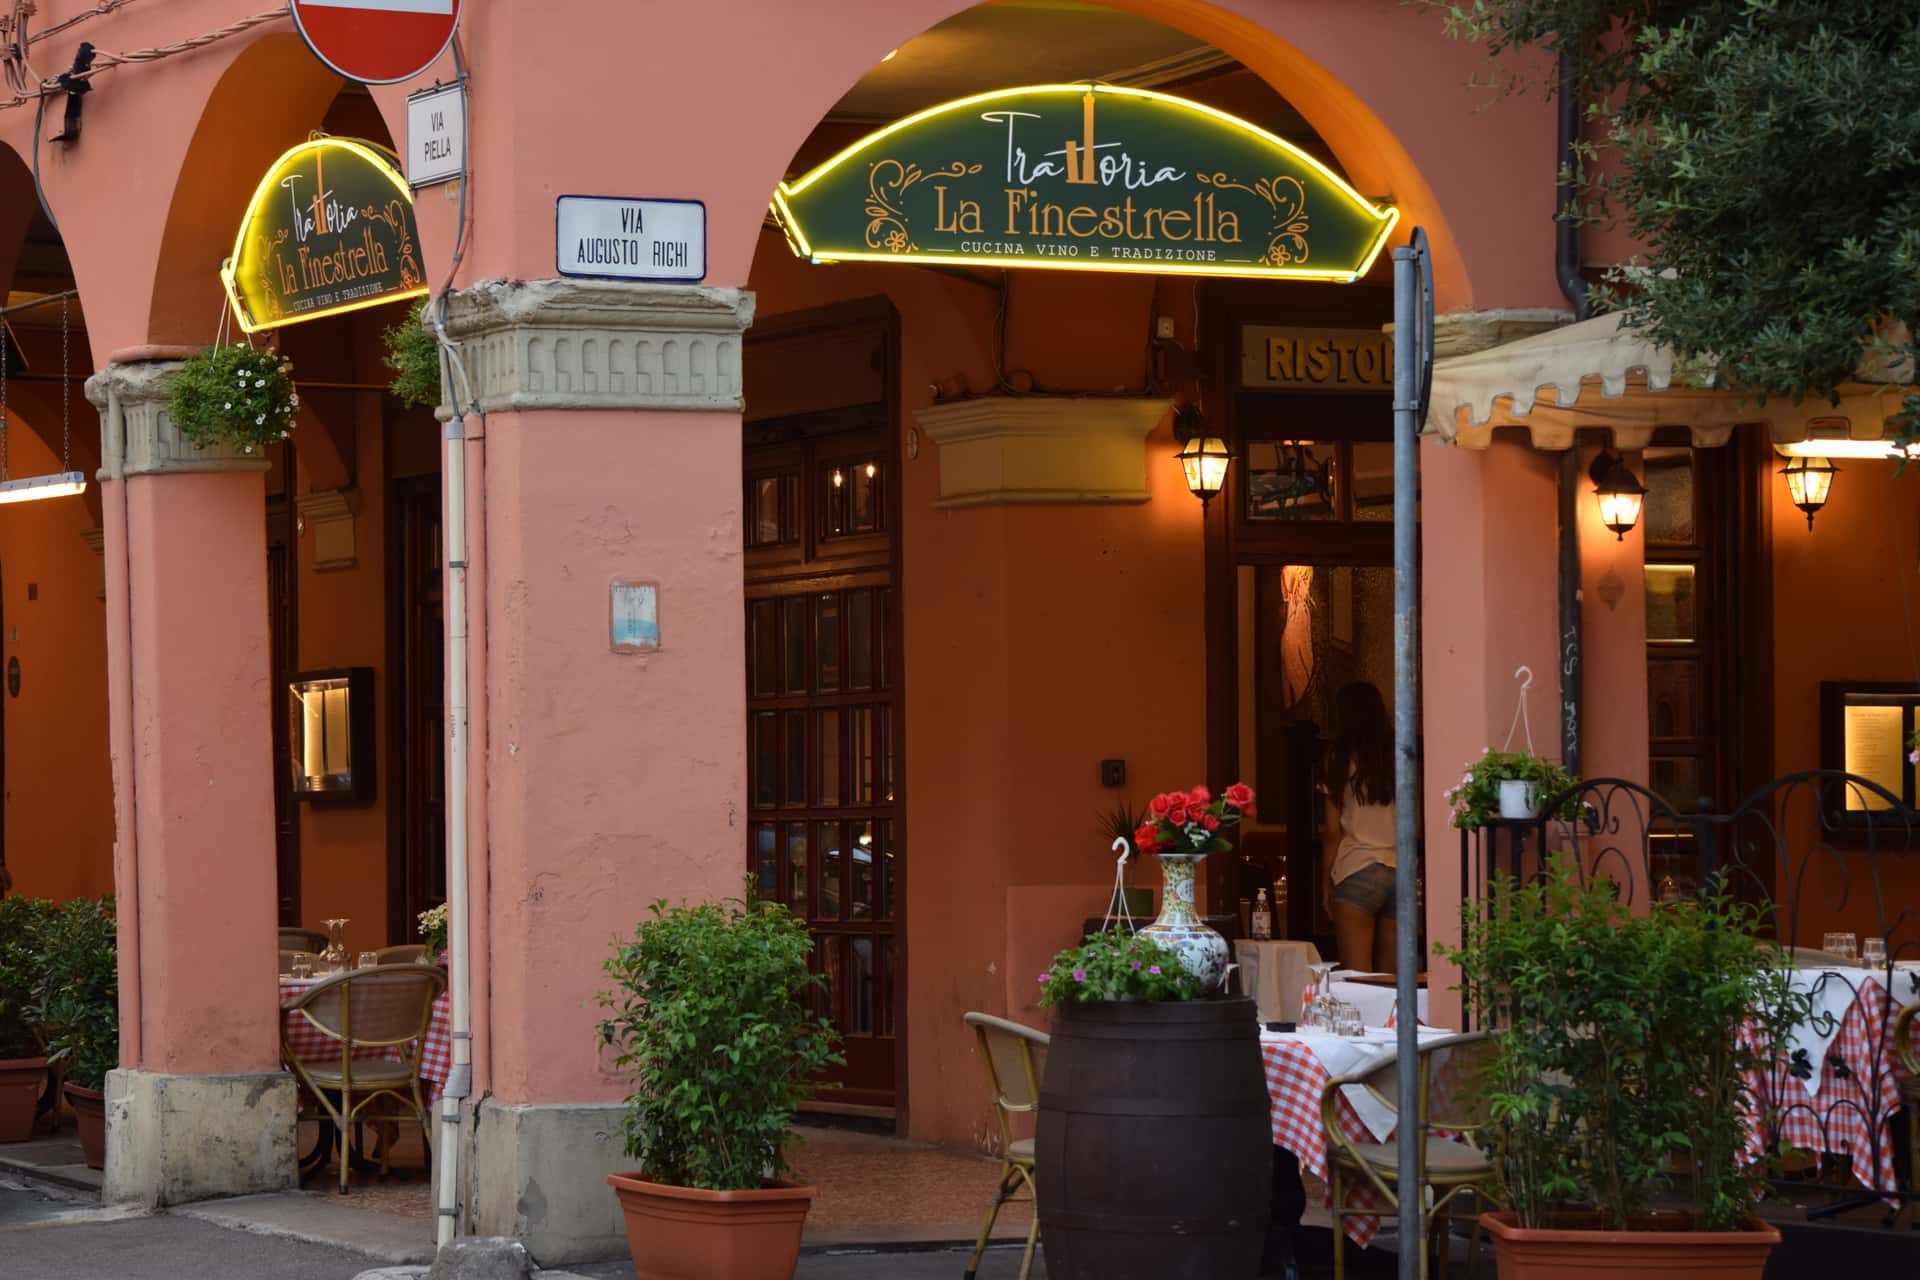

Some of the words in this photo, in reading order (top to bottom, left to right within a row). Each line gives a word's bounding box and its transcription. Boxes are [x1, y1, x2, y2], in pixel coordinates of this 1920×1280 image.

[431, 111, 444, 132] VIA
[424, 136, 452, 161] PIELLA
[981, 92, 1186, 189] Trattoria
[281, 147, 359, 242] Trattoria
[621, 207, 643, 234] VIA
[934, 186, 984, 234] La
[1004, 188, 1243, 243] Finestrella
[298, 226, 389, 290] Finestrella
[577, 238, 639, 265] AUGUSTO
[653, 240, 687, 267] RIGHI
[960, 241, 1025, 255] CUCINA
[1036, 244, 1079, 257] VINO
[1089, 246, 1100, 258] E
[1111, 247, 1216, 261] TRADIZIONE
